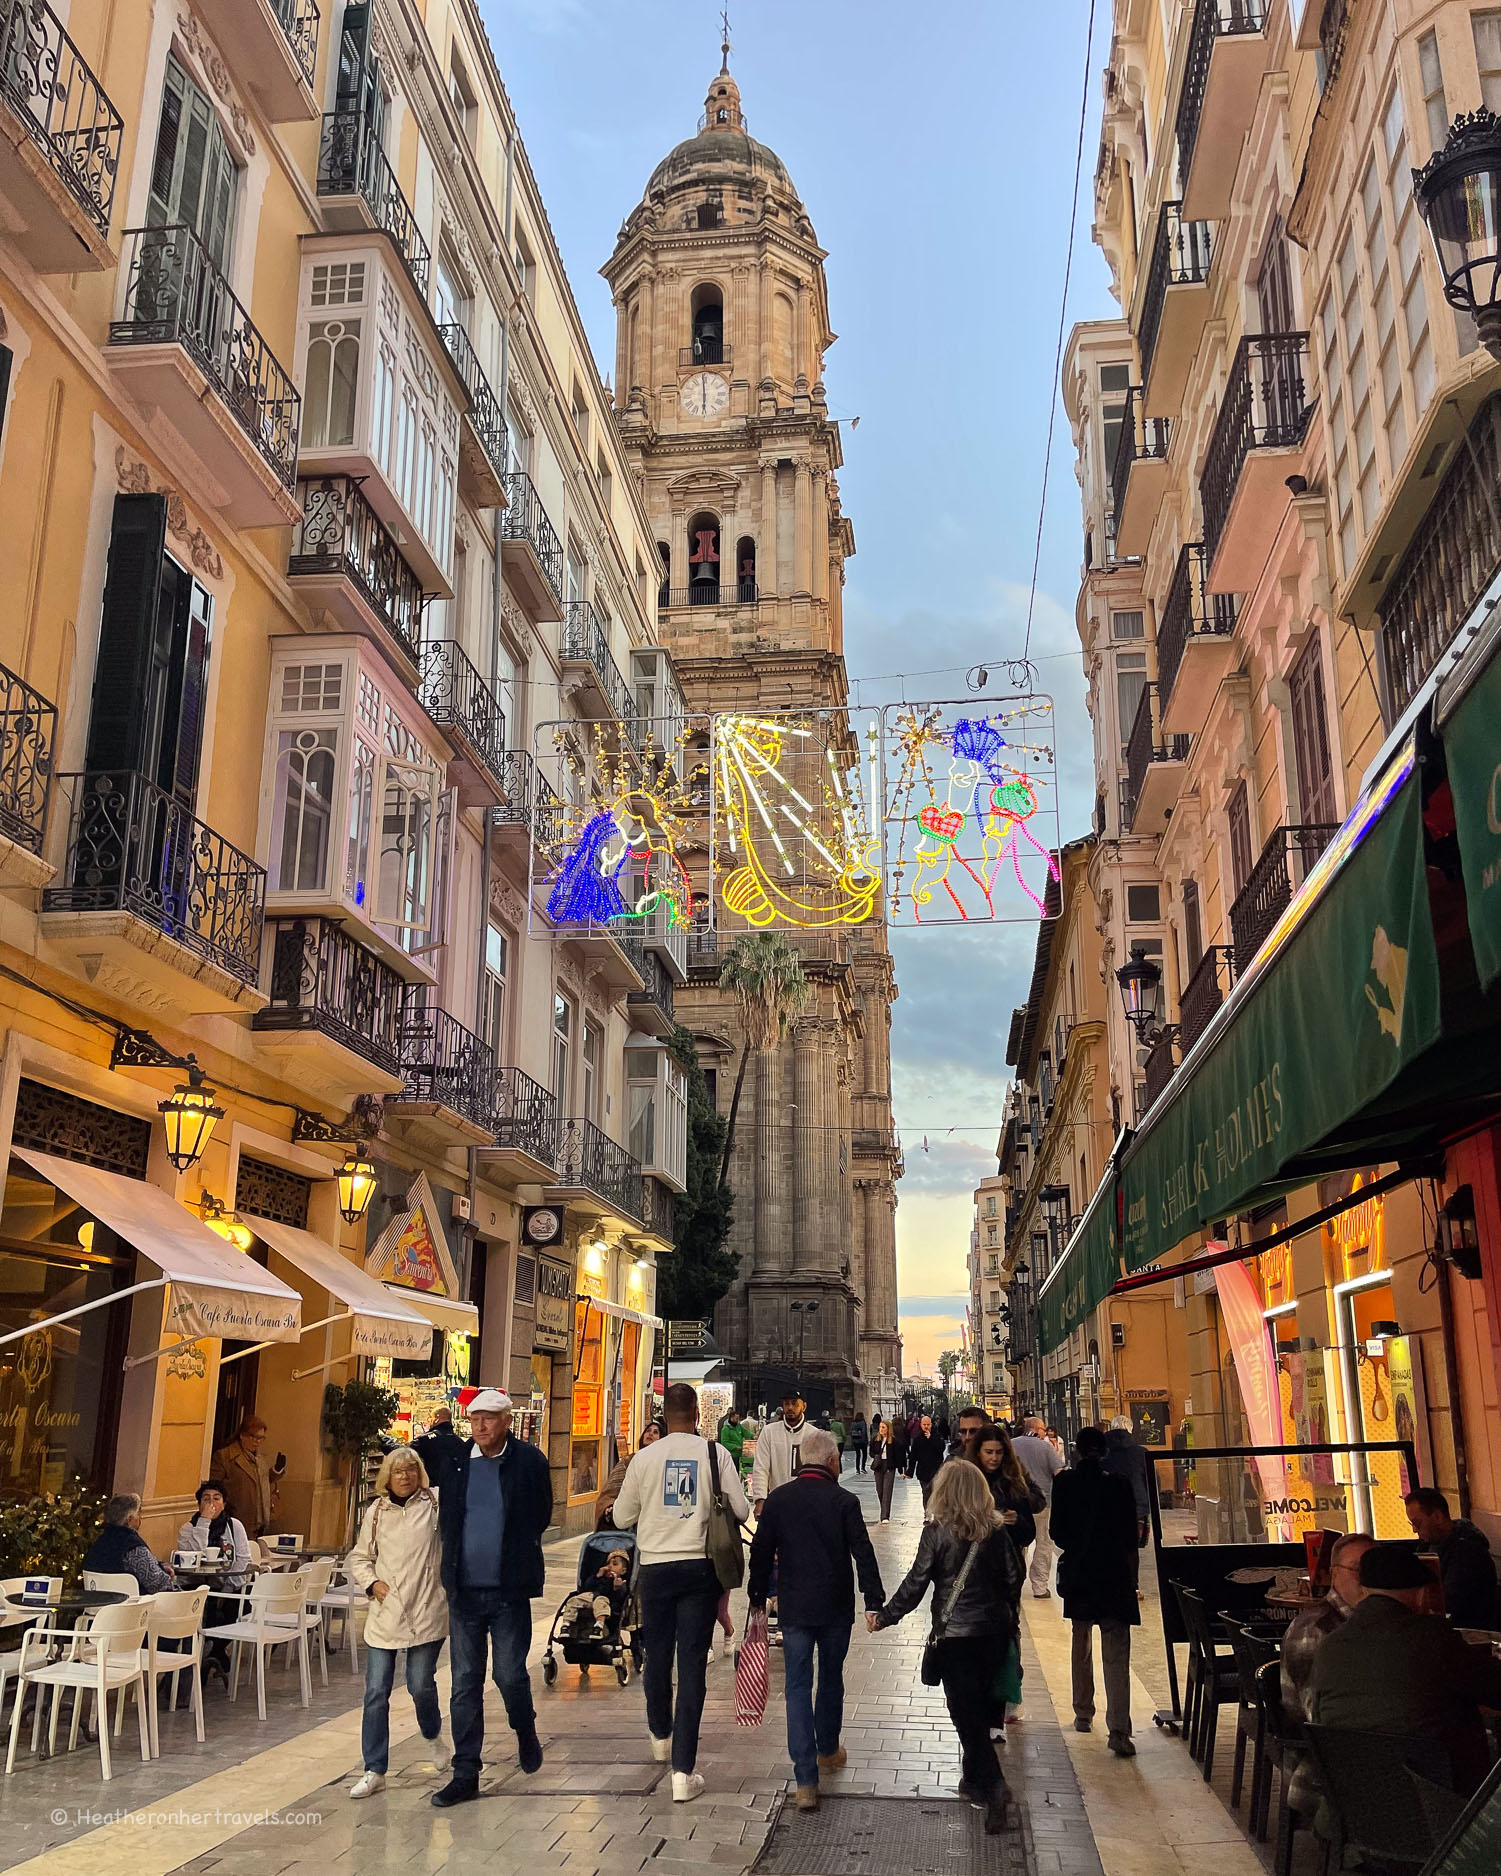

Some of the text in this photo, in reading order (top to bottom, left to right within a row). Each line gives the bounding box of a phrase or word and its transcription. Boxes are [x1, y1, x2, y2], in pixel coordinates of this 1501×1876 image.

[200, 1302, 221, 1328] Café
[223, 1307, 252, 1326] Puerta
[255, 1311, 280, 1328] Oscura
[35, 1400, 81, 1427] Oscura
